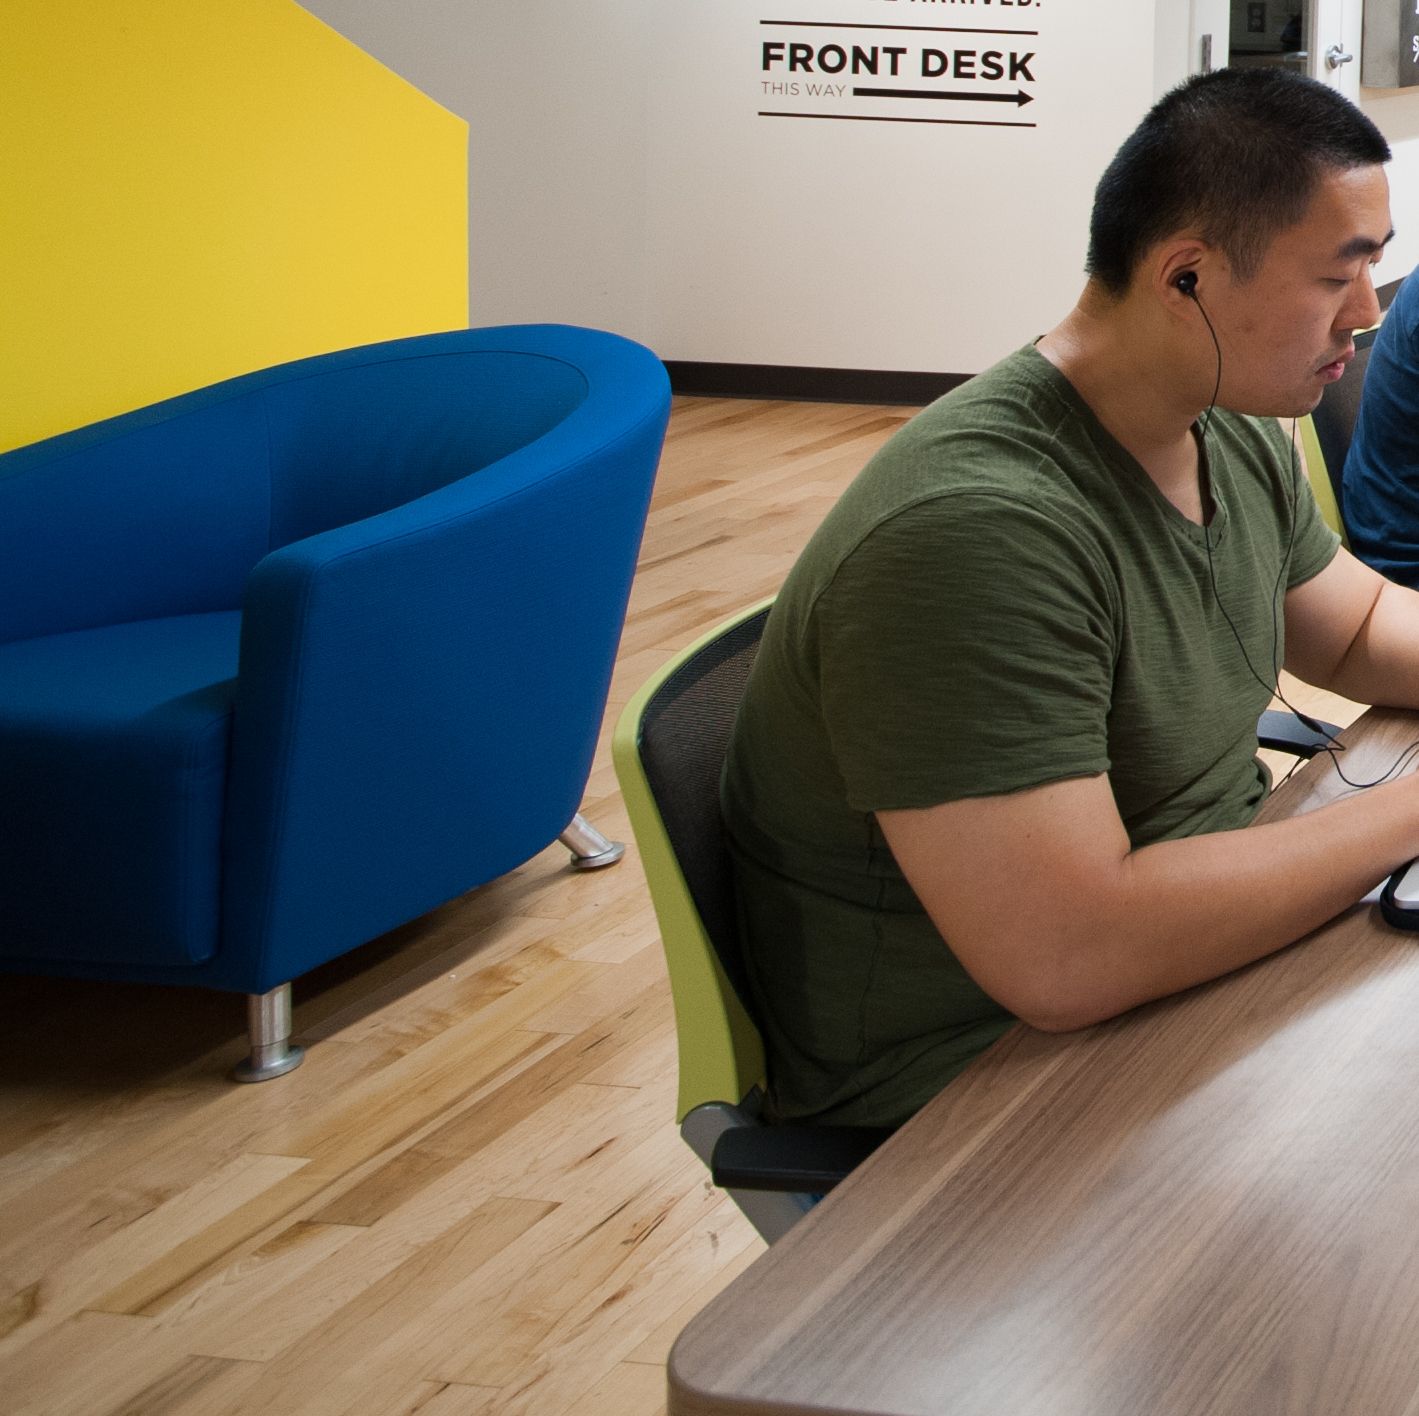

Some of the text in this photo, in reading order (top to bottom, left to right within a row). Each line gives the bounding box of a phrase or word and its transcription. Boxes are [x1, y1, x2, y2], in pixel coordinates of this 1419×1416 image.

[762, 41, 1036, 82] FRONT DESK
[761, 81, 846, 98] THIS WAY
